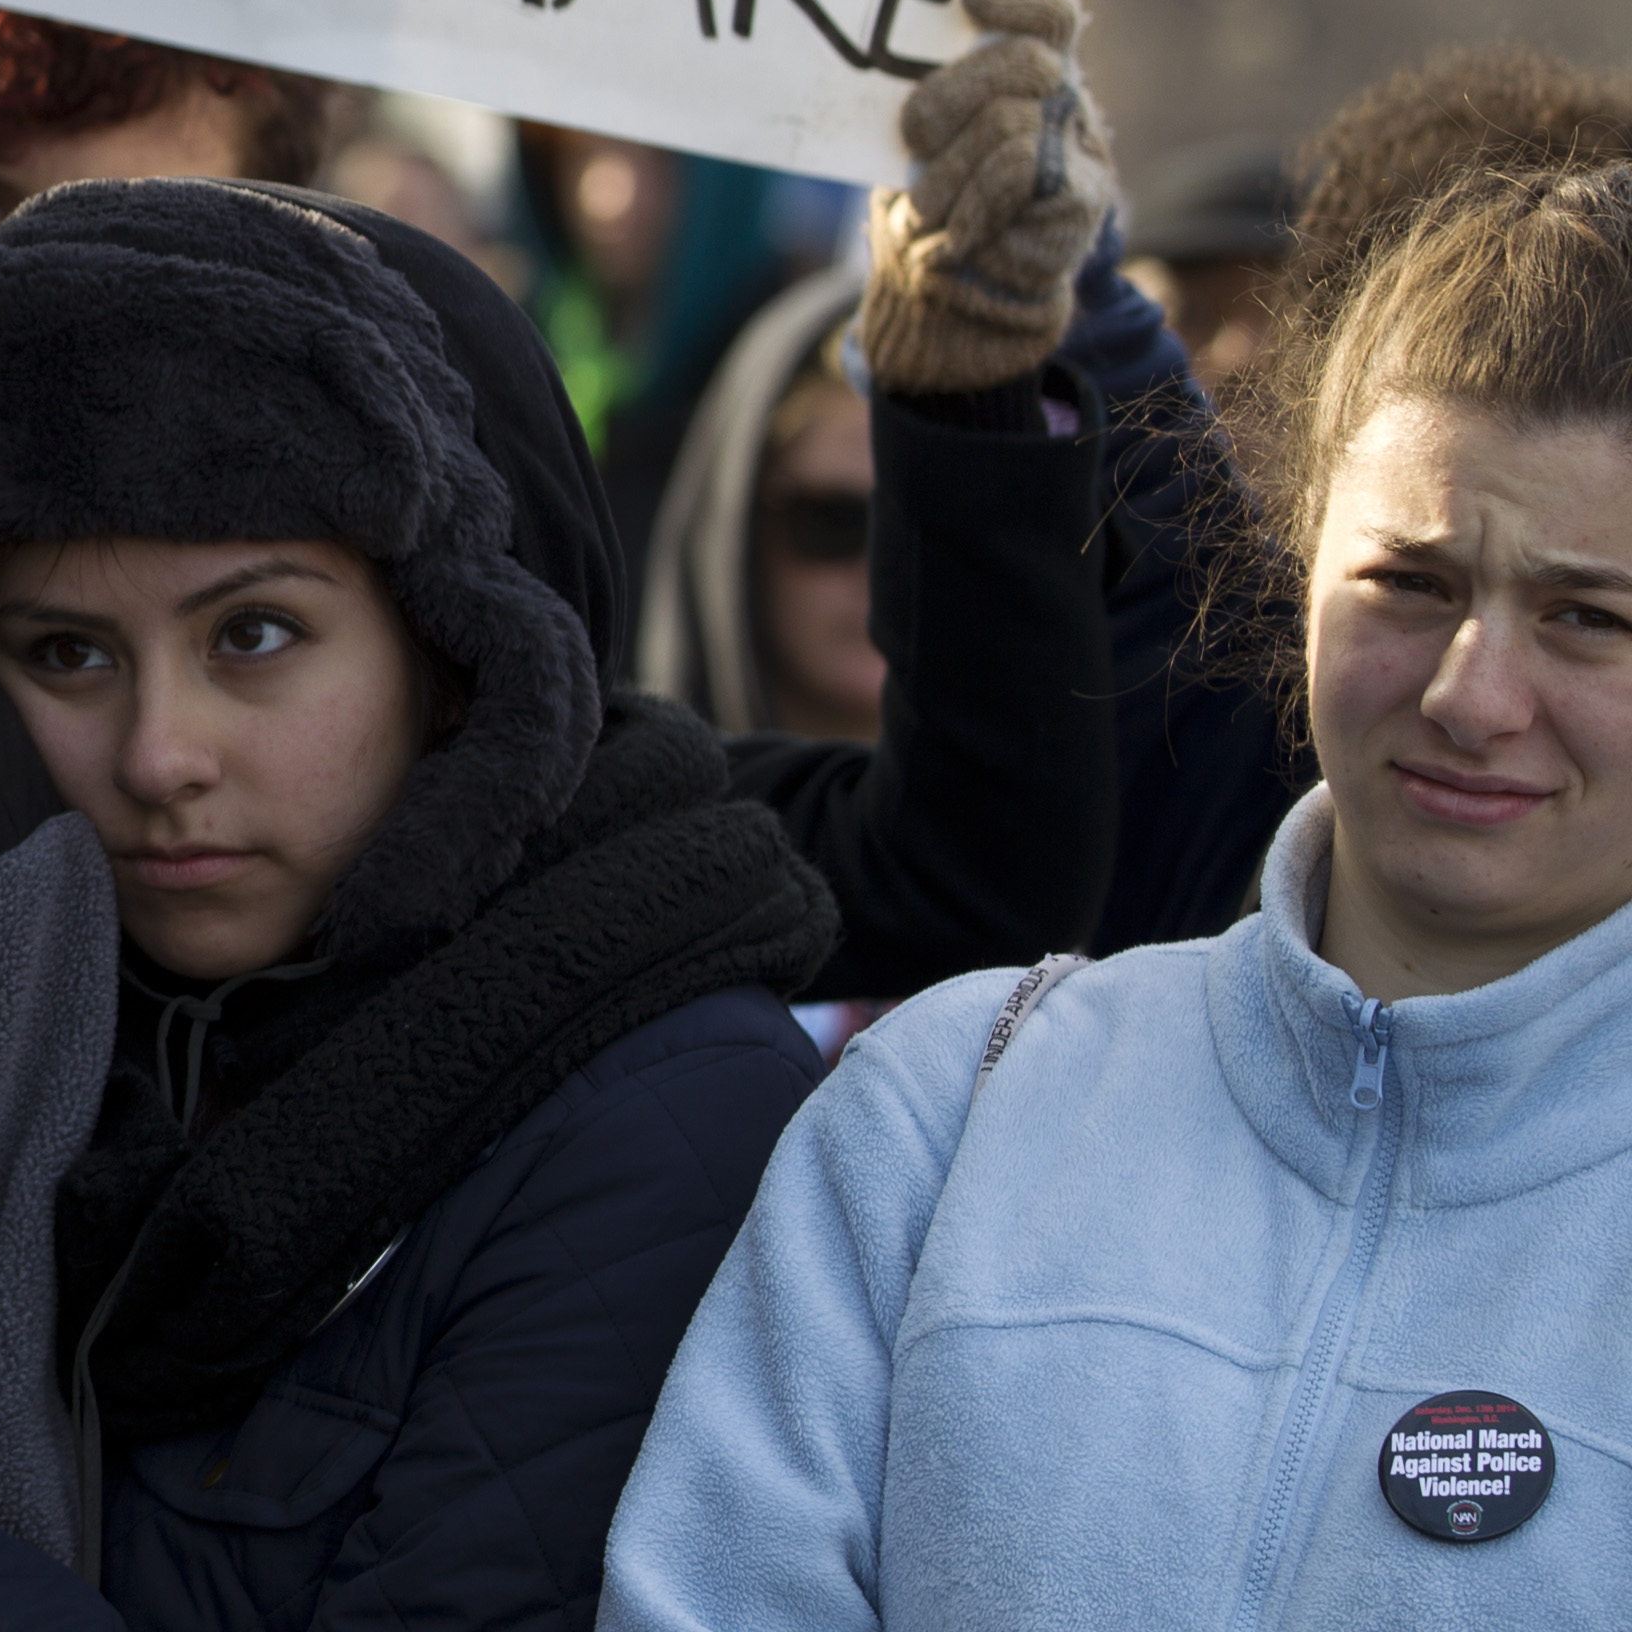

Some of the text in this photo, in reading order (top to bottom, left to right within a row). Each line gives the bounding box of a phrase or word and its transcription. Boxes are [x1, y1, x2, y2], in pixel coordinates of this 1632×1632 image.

[1391, 1429, 1542, 1452] National March
[1390, 1452, 1542, 1478] Against Police
[1419, 1475, 1511, 1497] Violence!
[1453, 1512, 1477, 1523] NAN
